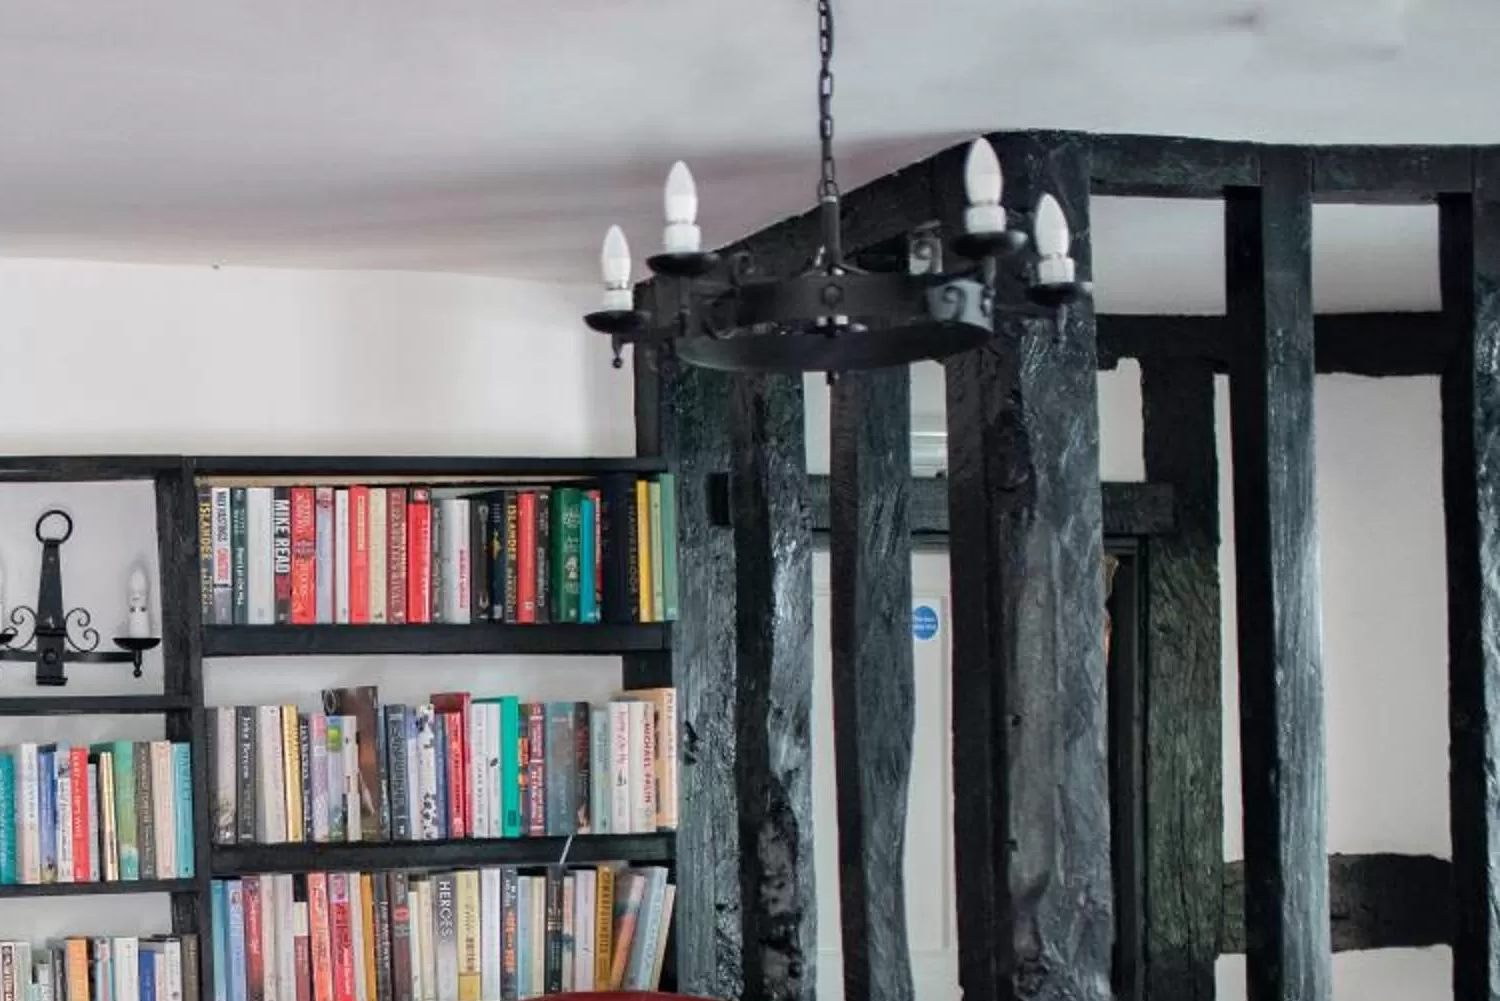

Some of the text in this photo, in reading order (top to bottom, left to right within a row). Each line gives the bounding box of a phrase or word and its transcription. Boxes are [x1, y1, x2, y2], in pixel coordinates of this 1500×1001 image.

[274, 500, 290, 573] MIKE READ
[643, 723, 652, 768] MICHAEL
